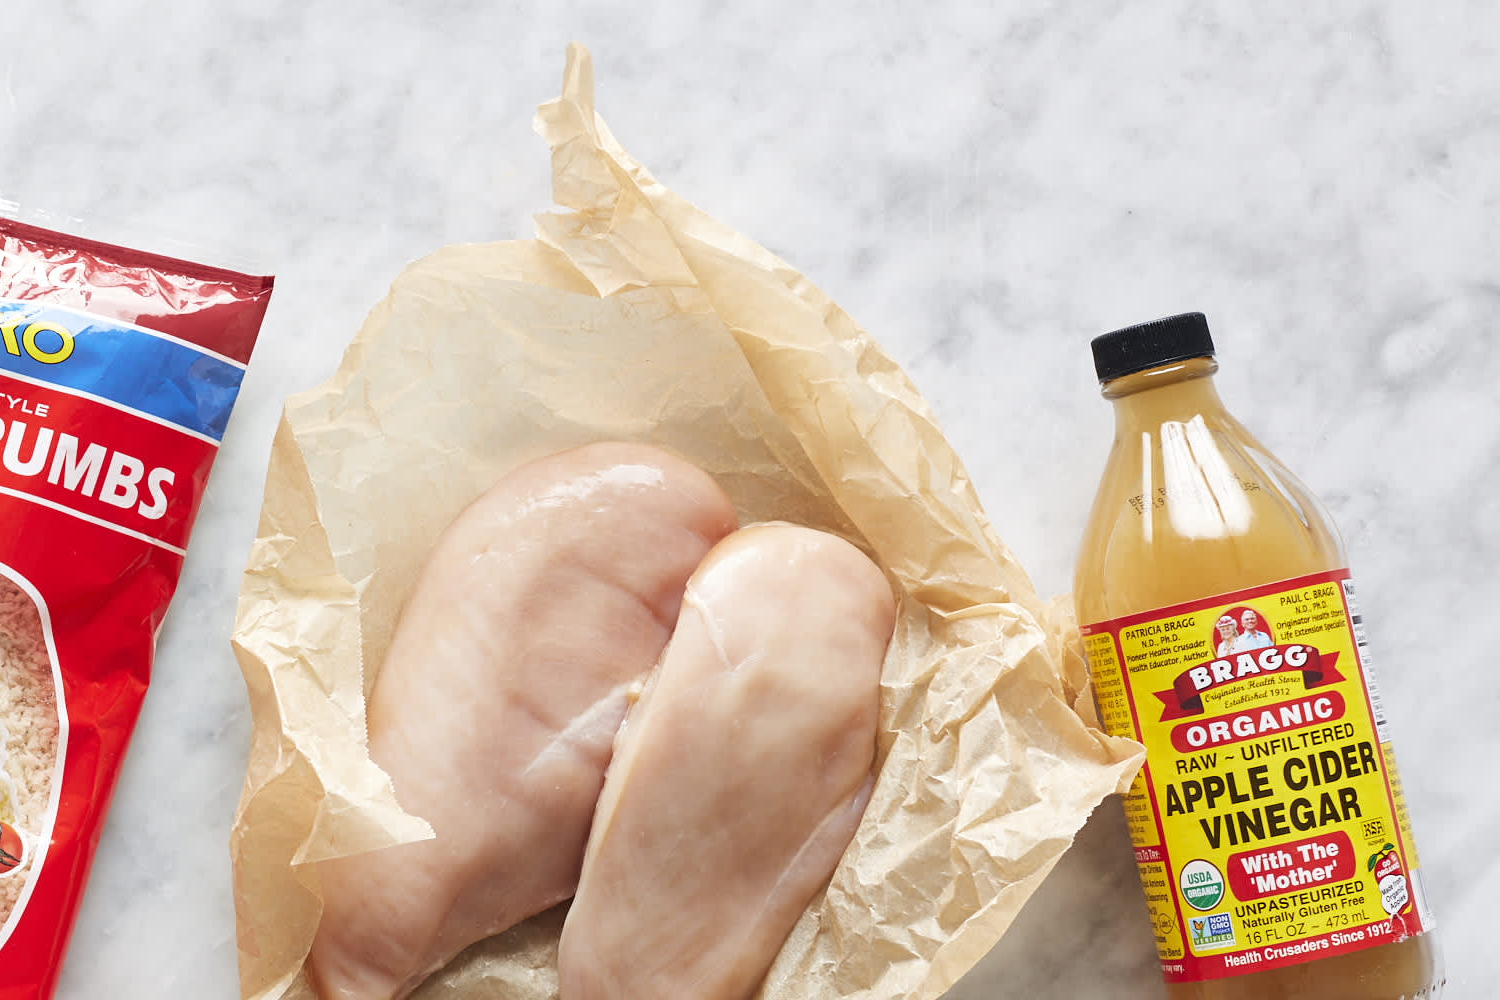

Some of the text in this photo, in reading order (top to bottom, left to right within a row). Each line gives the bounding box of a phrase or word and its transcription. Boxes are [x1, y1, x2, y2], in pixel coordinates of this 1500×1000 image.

[1280, 586, 1334, 606] PAUL BRAGG
[1125, 618, 1195, 640] PATRICIA BRAGG
[1149, 640, 1205, 657] Health Crusader
[1183, 650, 1209, 662] Author
[1189, 645, 1308, 691] BRAGG
[1205, 678, 1276, 703] Originator Health
[1224, 688, 1291, 708] Established 1912
[1186, 697, 1333, 747] ORGANIC
[1176, 722, 1355, 775] RAW UNFILTERED
[1166, 765, 1271, 816] APPLE
[1283, 741, 1377, 791] CIDER
[1200, 787, 1362, 849] VINEGAR
[1240, 842, 1339, 875] With The
[1187, 870, 1212, 884] USDA
[1187, 883, 1220, 898] ORGANIC
[1251, 863, 1338, 894] 'Mother'
[1235, 880, 1364, 918] UNPASTEURIZED
[1242, 896, 1365, 930] Naturally Gluten Free
[1194, 934, 1234, 946] VERIFIED
[1245, 910, 1369, 945] 16 FL OZ 473 mL
[1224, 922, 1392, 968] Health Crusaders Since 1912
